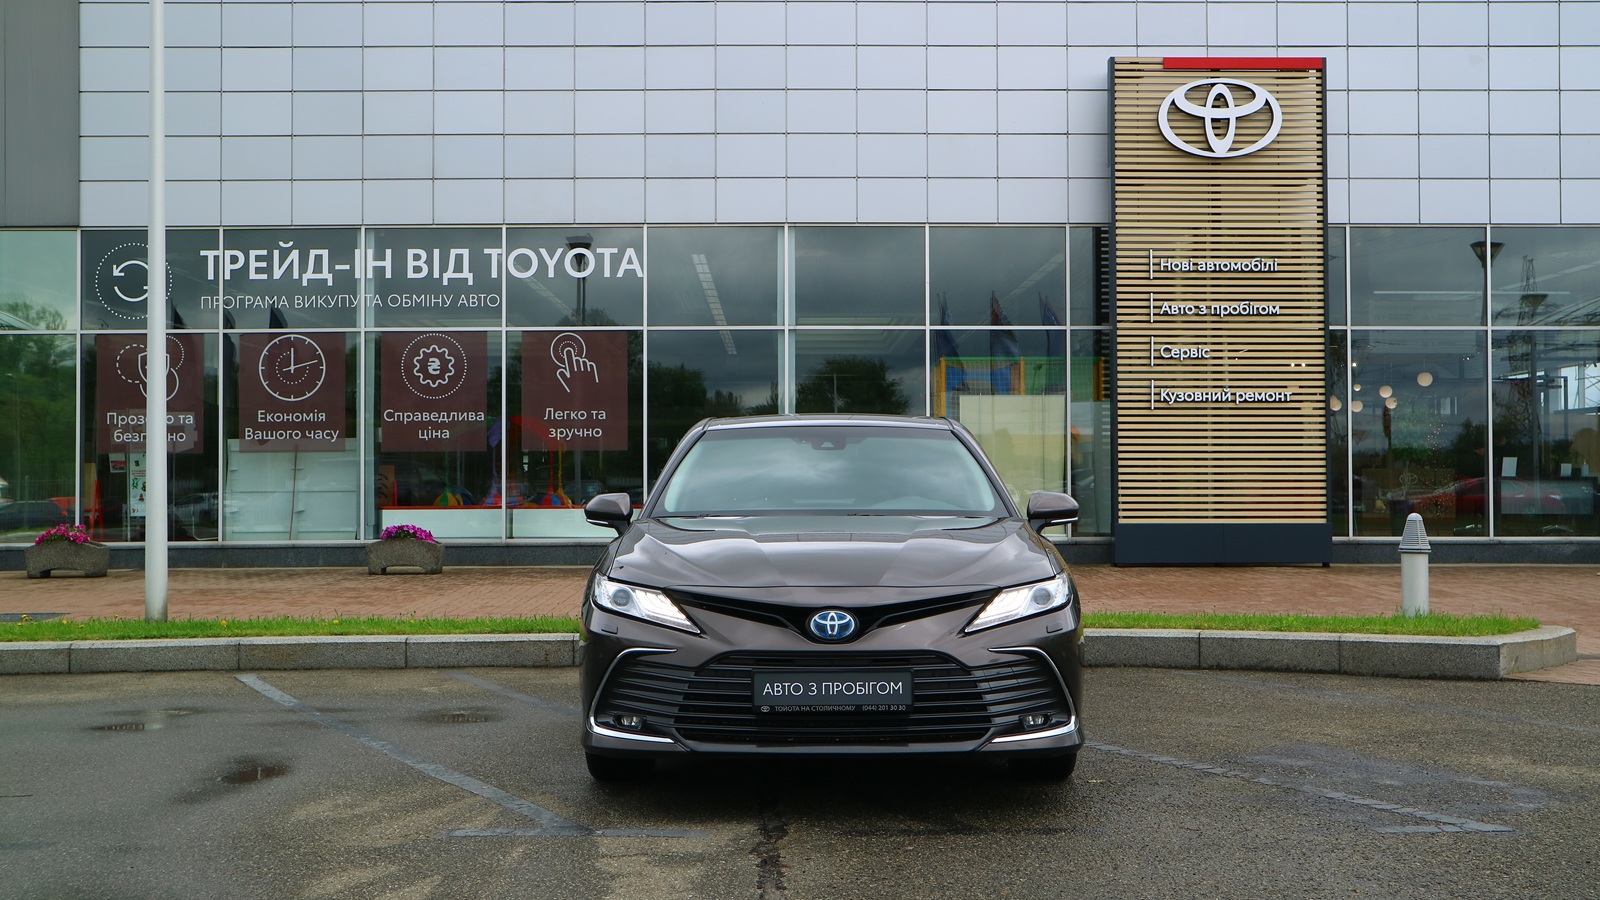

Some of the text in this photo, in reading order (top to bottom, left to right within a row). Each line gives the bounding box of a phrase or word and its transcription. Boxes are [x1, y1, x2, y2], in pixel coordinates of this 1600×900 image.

[200, 241, 645, 287] ТРЕЙД-ІН ВІД TOYOTA
[1160, 258, 1279, 272] Нові автомобілі
[200, 293, 500, 310] ПРОГРАМА ВИКУПУ ТА ОБМІНУ АВТО
[1160, 301, 1280, 318] Авто з пробігом
[1160, 345, 1211, 361] Сервіс
[1160, 388, 1293, 405] Кузовний ремонт
[106, 412, 194, 427] Прозо та
[257, 409, 326, 422] Економія
[383, 409, 485, 424] Справедлива
[543, 407, 607, 420] Легко та
[245, 427, 340, 442] Вашого часу
[418, 426, 450, 441] ціна
[548, 427, 603, 441] зручно
[762, 681, 903, 696] АВТО З ПРОБІГОМ
